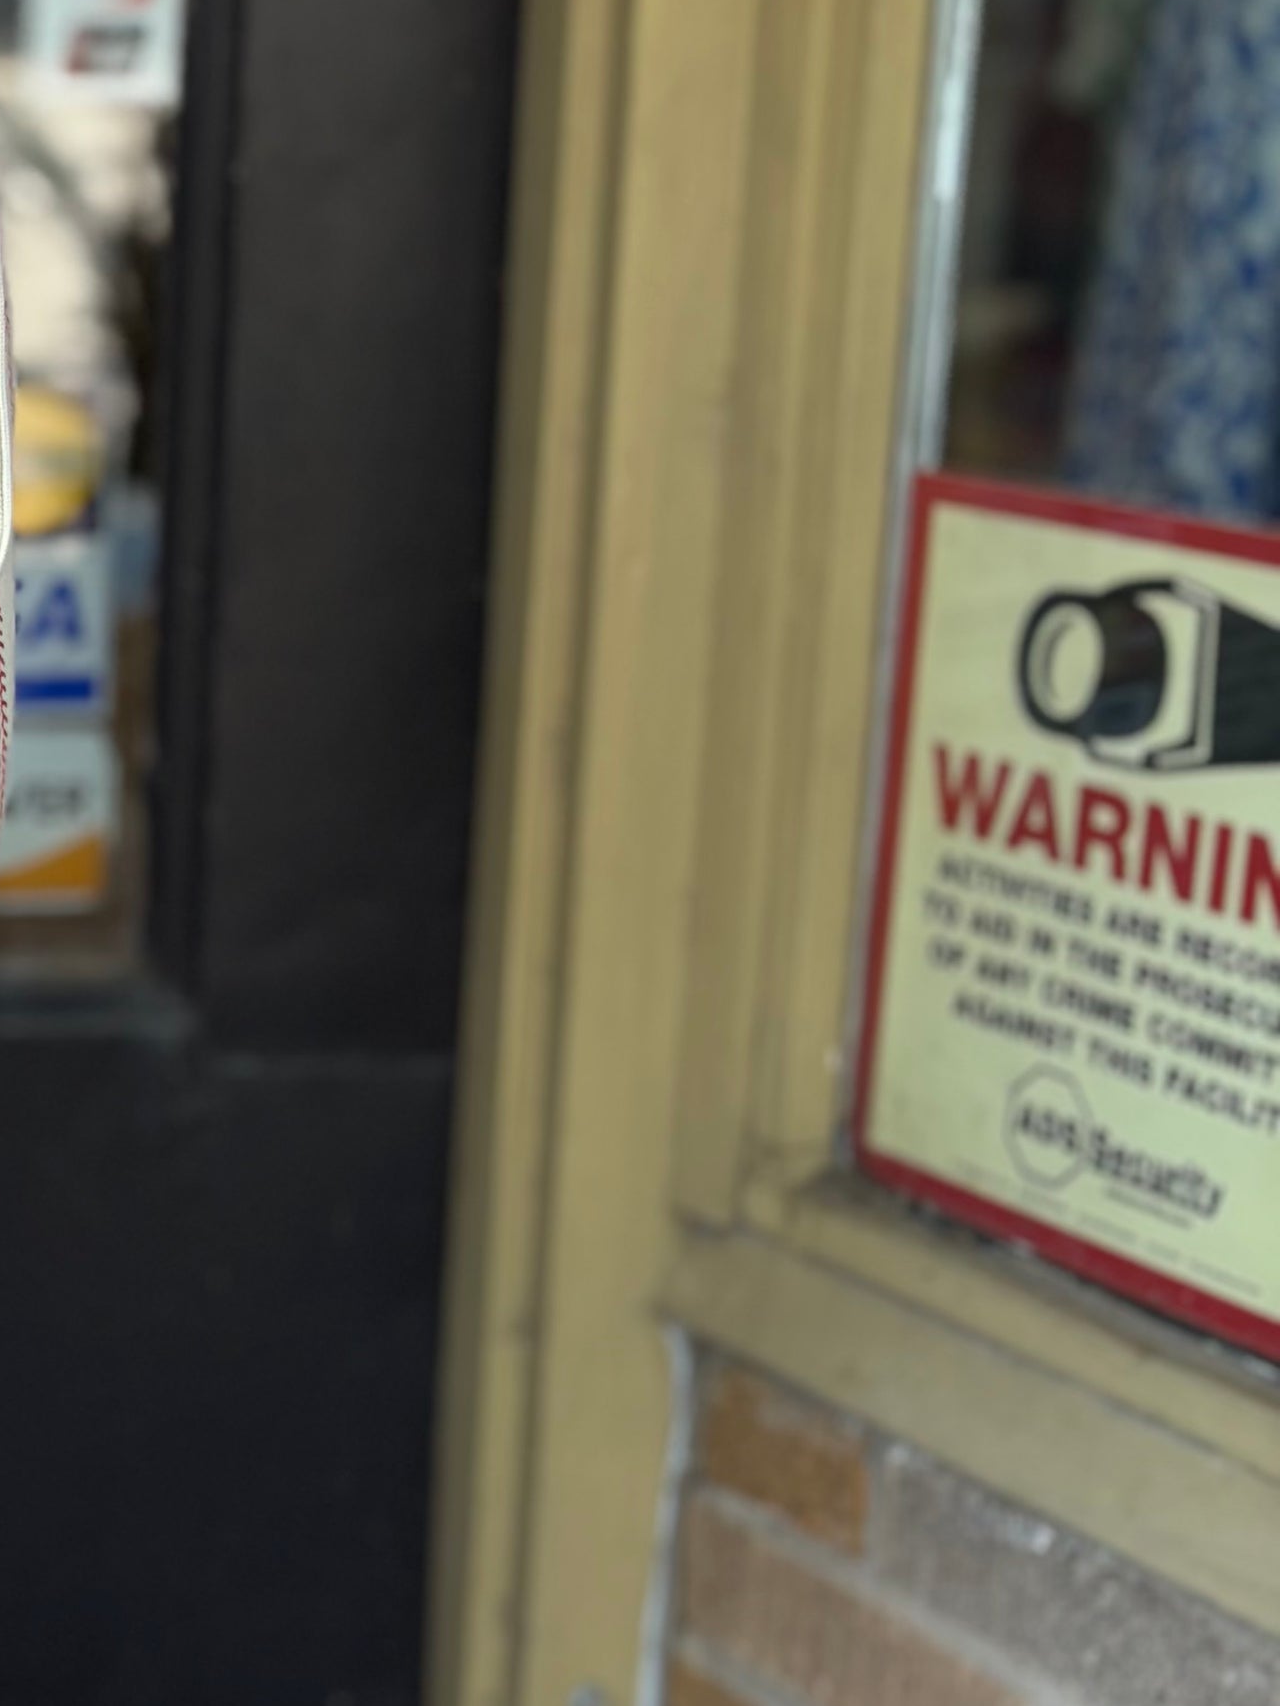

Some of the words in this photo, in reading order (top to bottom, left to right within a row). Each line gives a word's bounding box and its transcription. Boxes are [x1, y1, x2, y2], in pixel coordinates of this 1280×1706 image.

[924, 889, 959, 927] TO
[971, 909, 1015, 945] AID
[1030, 928, 1056, 955] IN
[1068, 937, 1121, 980] THE
[1105, 908, 1161, 949] ARE
[929, 938, 965, 968] OF
[976, 955, 1030, 989] ANY
[1044, 977, 1134, 1031] CRIME
[952, 992, 1076, 1052] AGAINST
[1088, 1036, 1153, 1084] THIS
